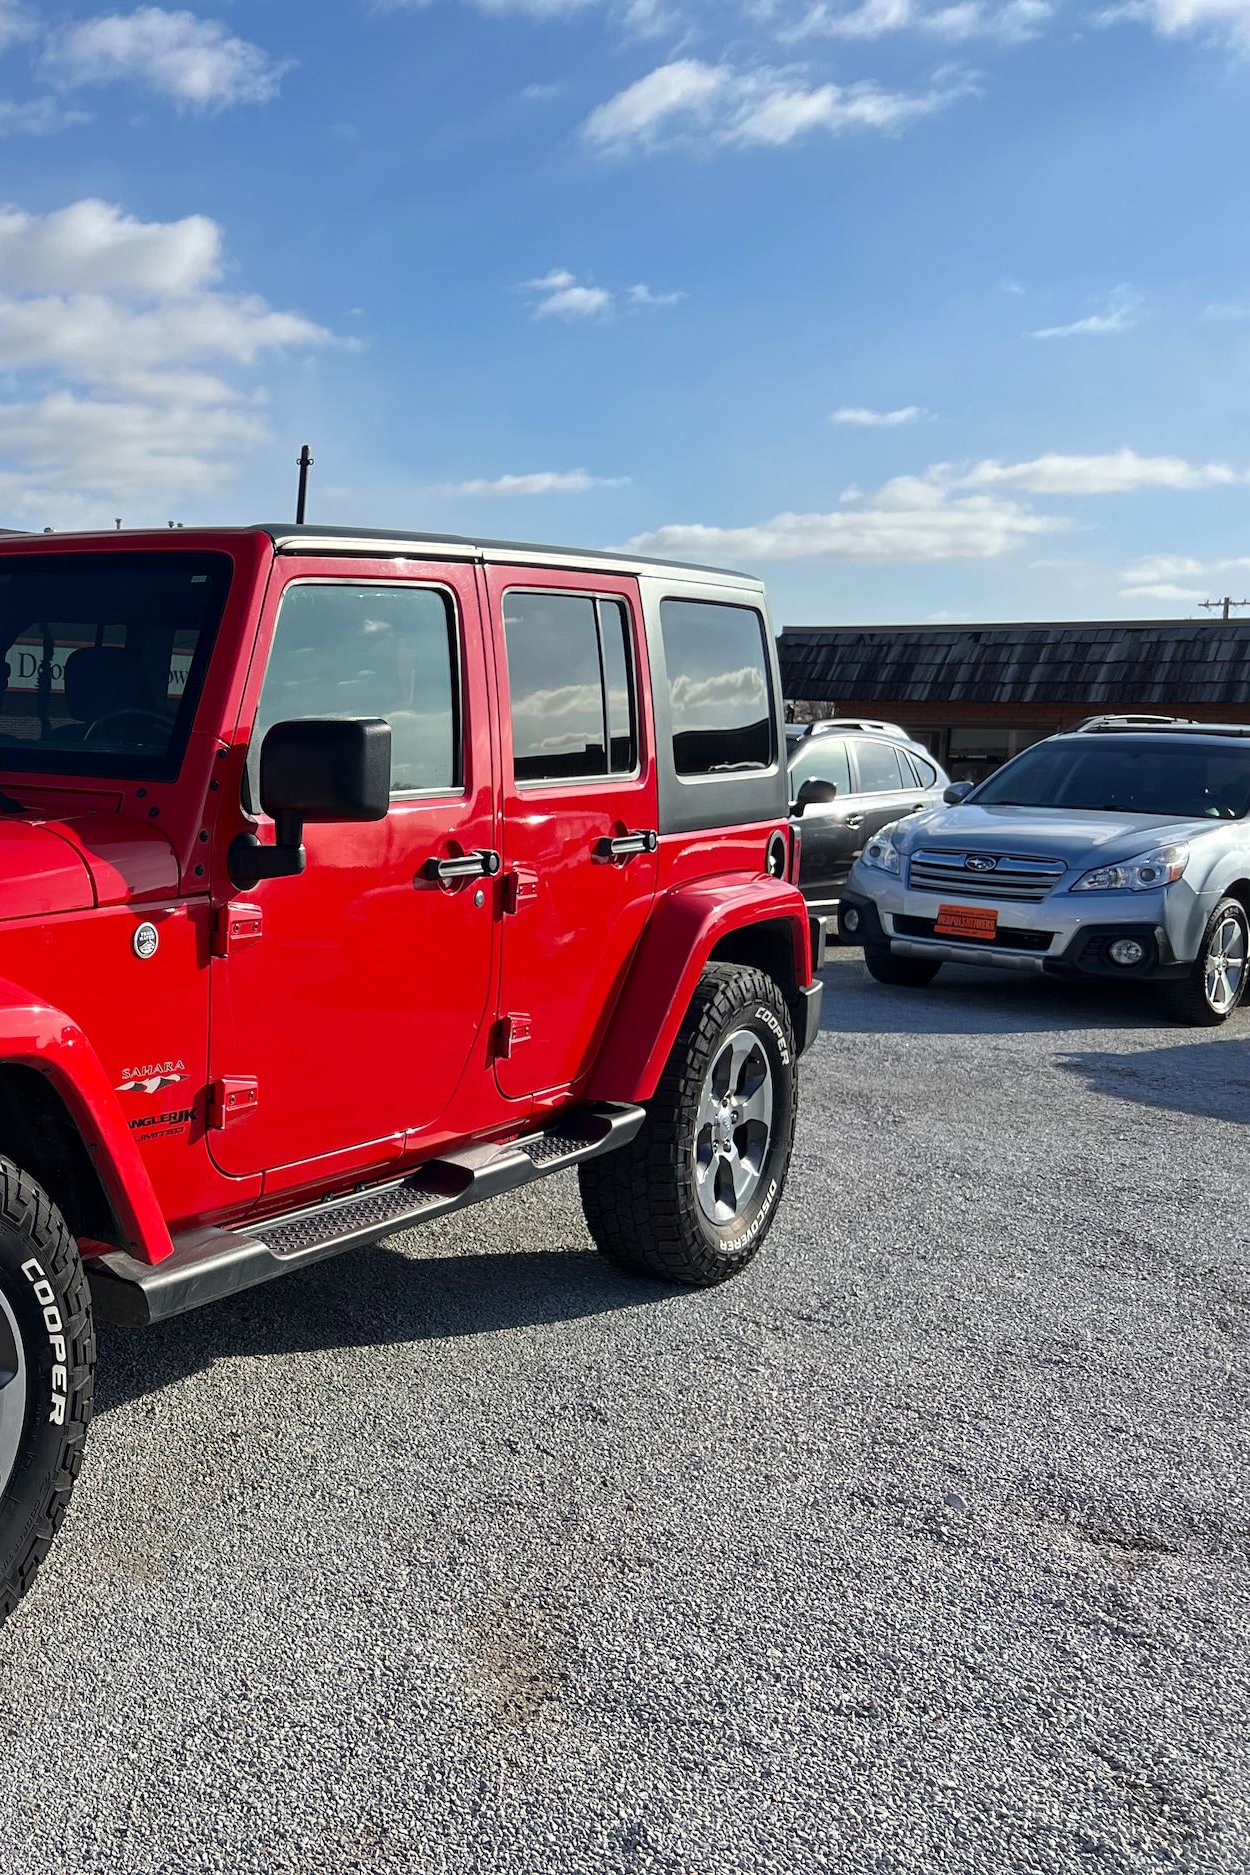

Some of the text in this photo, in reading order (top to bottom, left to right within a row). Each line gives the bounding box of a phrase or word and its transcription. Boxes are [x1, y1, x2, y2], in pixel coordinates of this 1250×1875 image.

[121, 1060, 185, 1079] SAHARA
[755, 1006, 789, 1066] COOPER
[720, 1177, 778, 1252] DISCOVERER
[21, 1257, 67, 1426] COOPER
